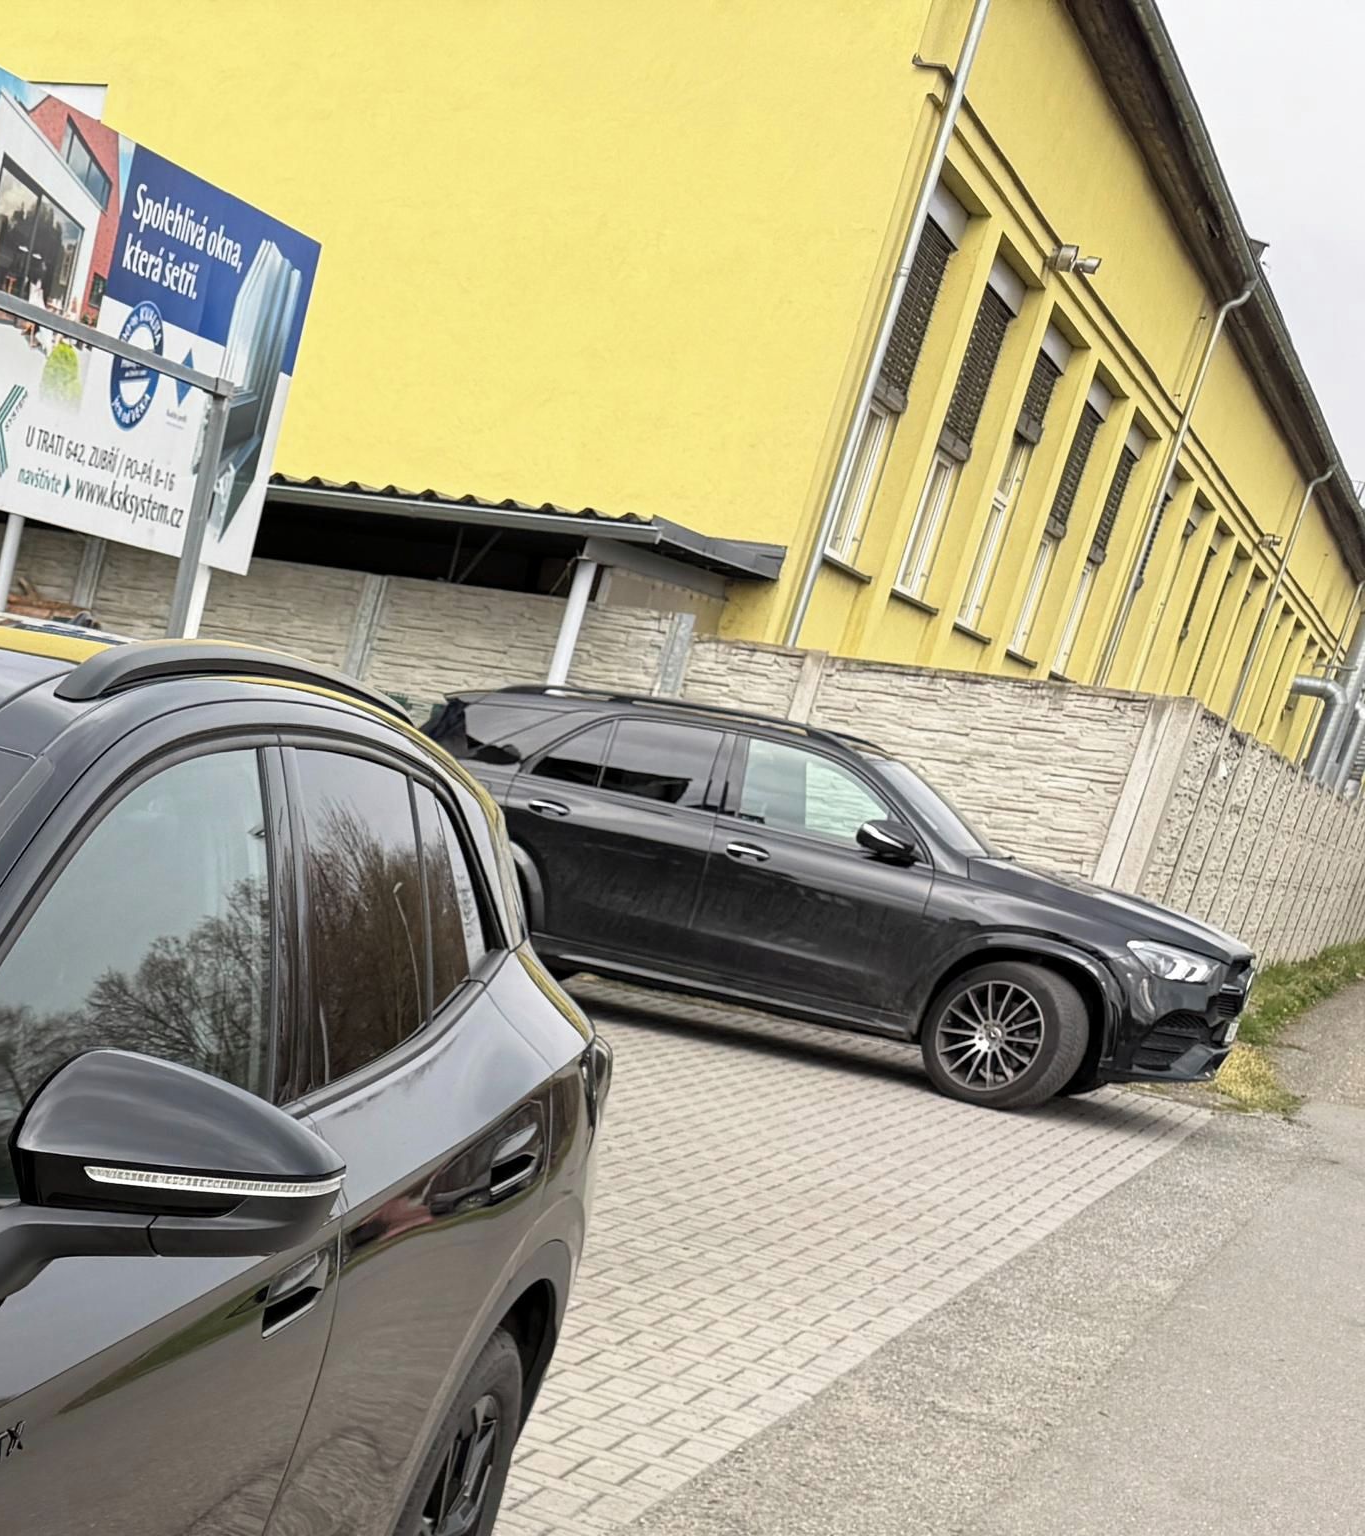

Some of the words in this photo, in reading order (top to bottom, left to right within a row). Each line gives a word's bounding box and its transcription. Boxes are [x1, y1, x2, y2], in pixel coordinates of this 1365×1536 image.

[132, 183, 209, 252] Spolehlivá
[206, 224, 243, 275] okna,
[122, 232, 165, 283] která
[162, 252, 200, 300] šetří.
[25, 425, 36, 448] U
[37, 428, 65, 457] TRATI
[88, 446, 121, 474] ZUBŘÍ
[124, 458, 153, 487] PO-PÁ
[74, 477, 185, 530] www.ksksystem.cz
